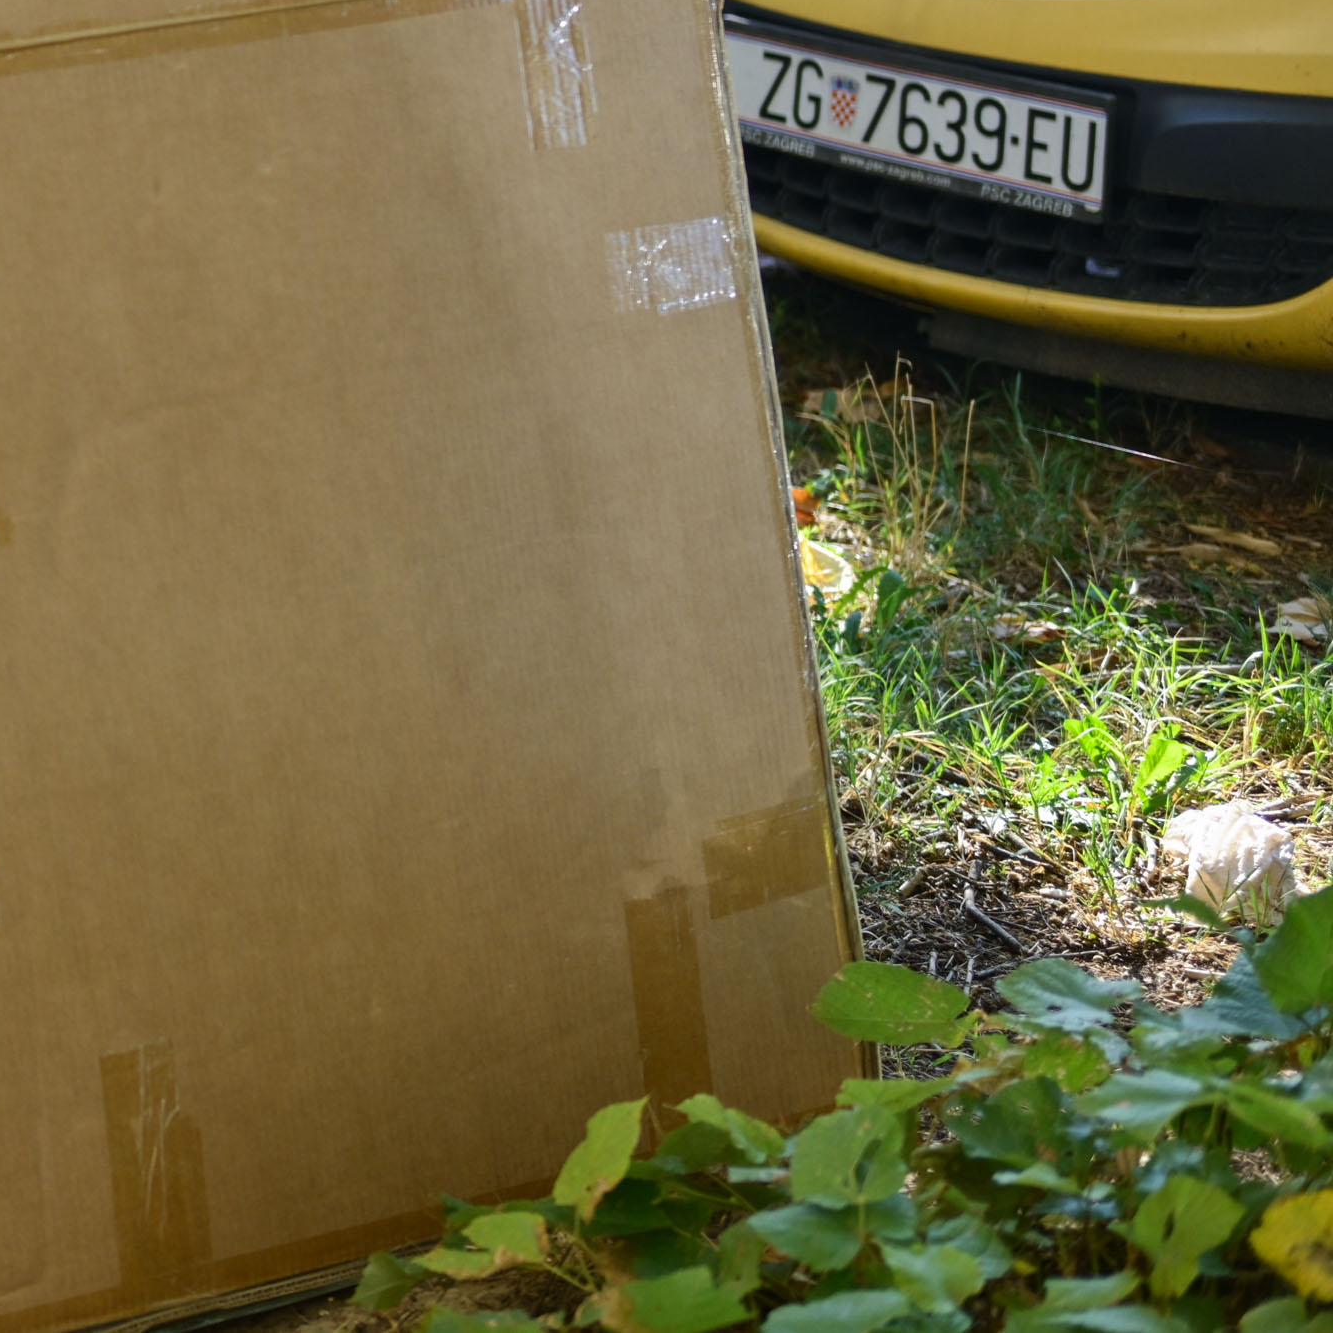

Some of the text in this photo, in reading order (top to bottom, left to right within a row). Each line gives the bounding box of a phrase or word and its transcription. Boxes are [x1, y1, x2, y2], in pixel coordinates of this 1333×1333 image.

[758, 50, 823, 130] ZG
[981, 184, 1074, 218] PSC ZAGREB
